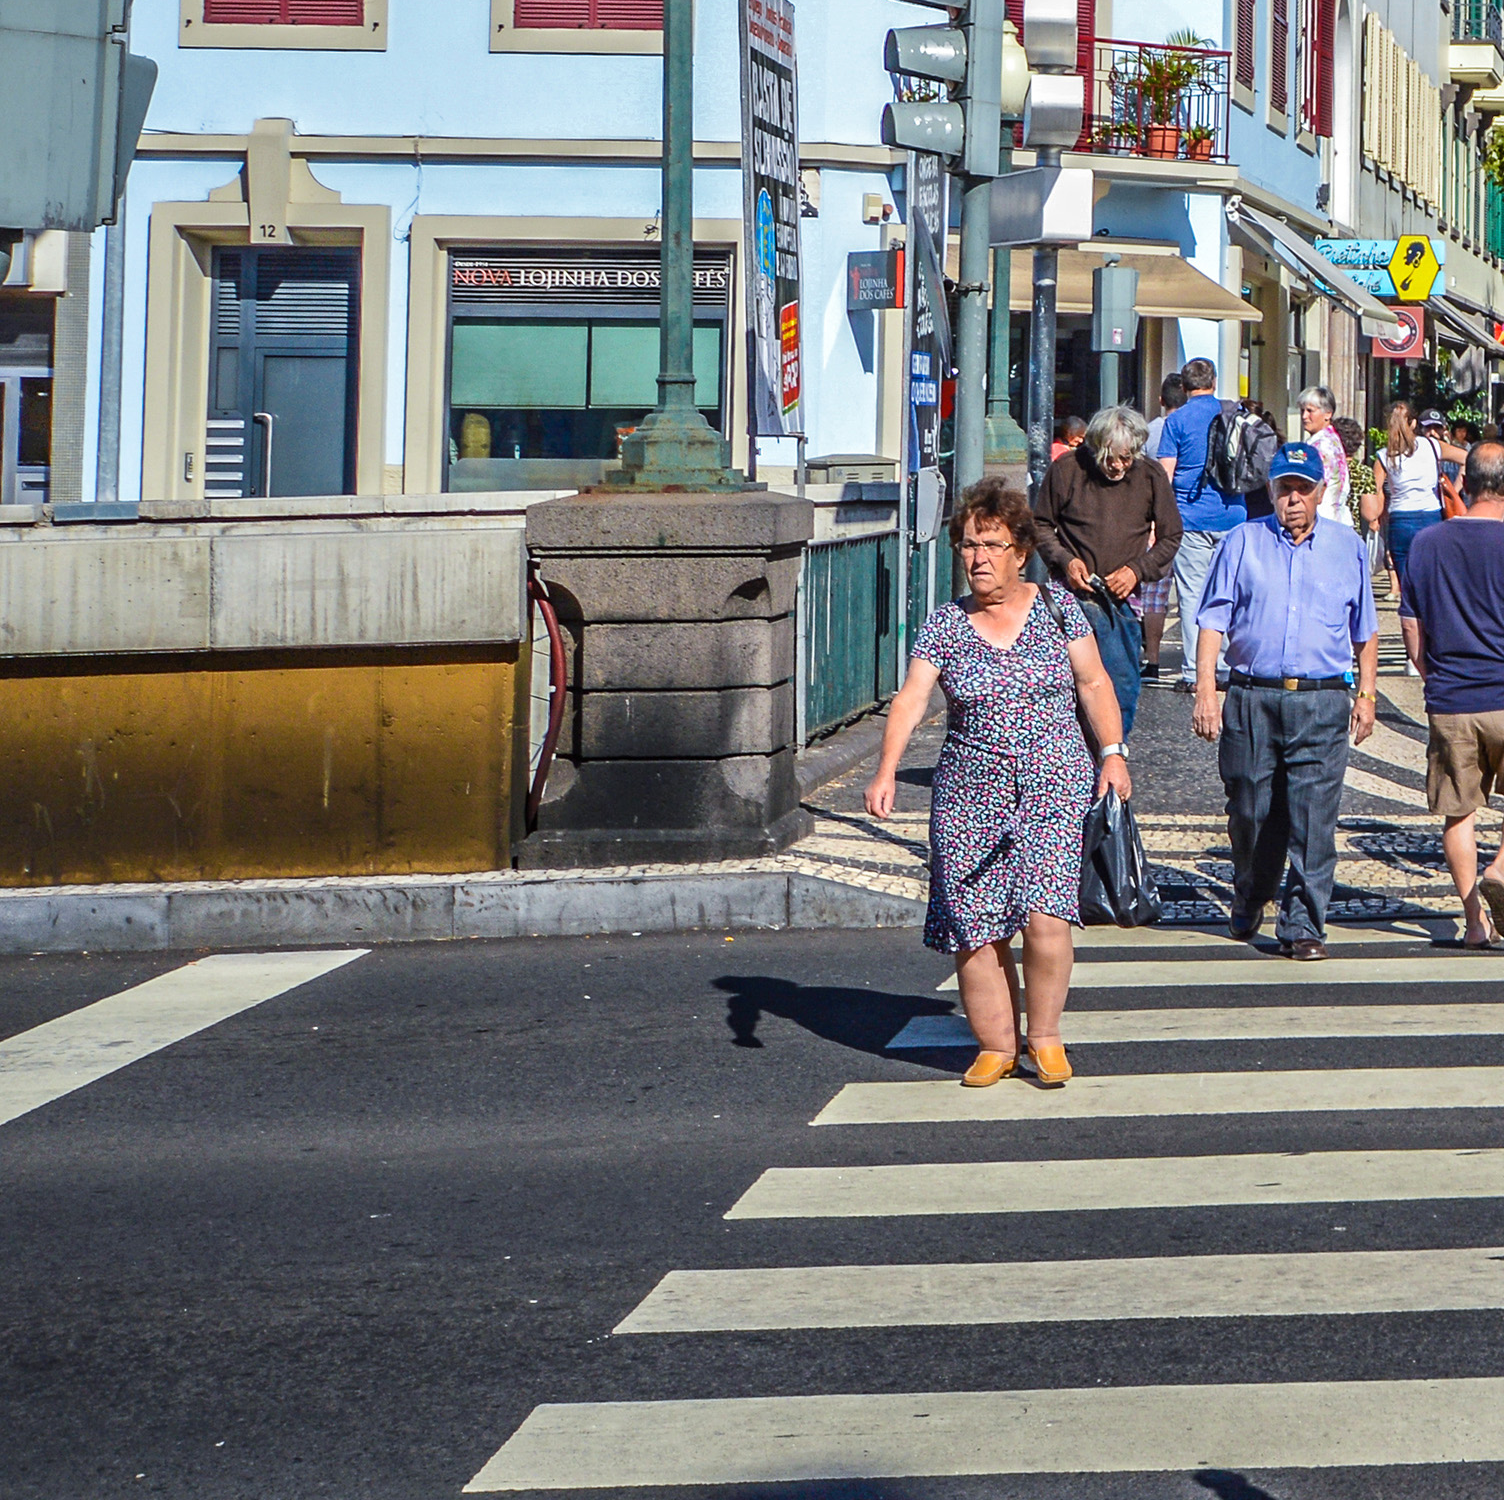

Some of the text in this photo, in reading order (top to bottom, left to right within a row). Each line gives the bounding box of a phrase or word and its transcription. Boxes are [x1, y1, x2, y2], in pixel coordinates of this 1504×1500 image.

[260, 224, 276, 238] 12
[454, 269, 512, 285] NOVA
[520, 269, 610, 289] LOJINHA
[617, 270, 660, 287] DOS
[860, 279, 888, 289] LOJINHA
[860, 287, 895, 300] DOS CAFÉS
